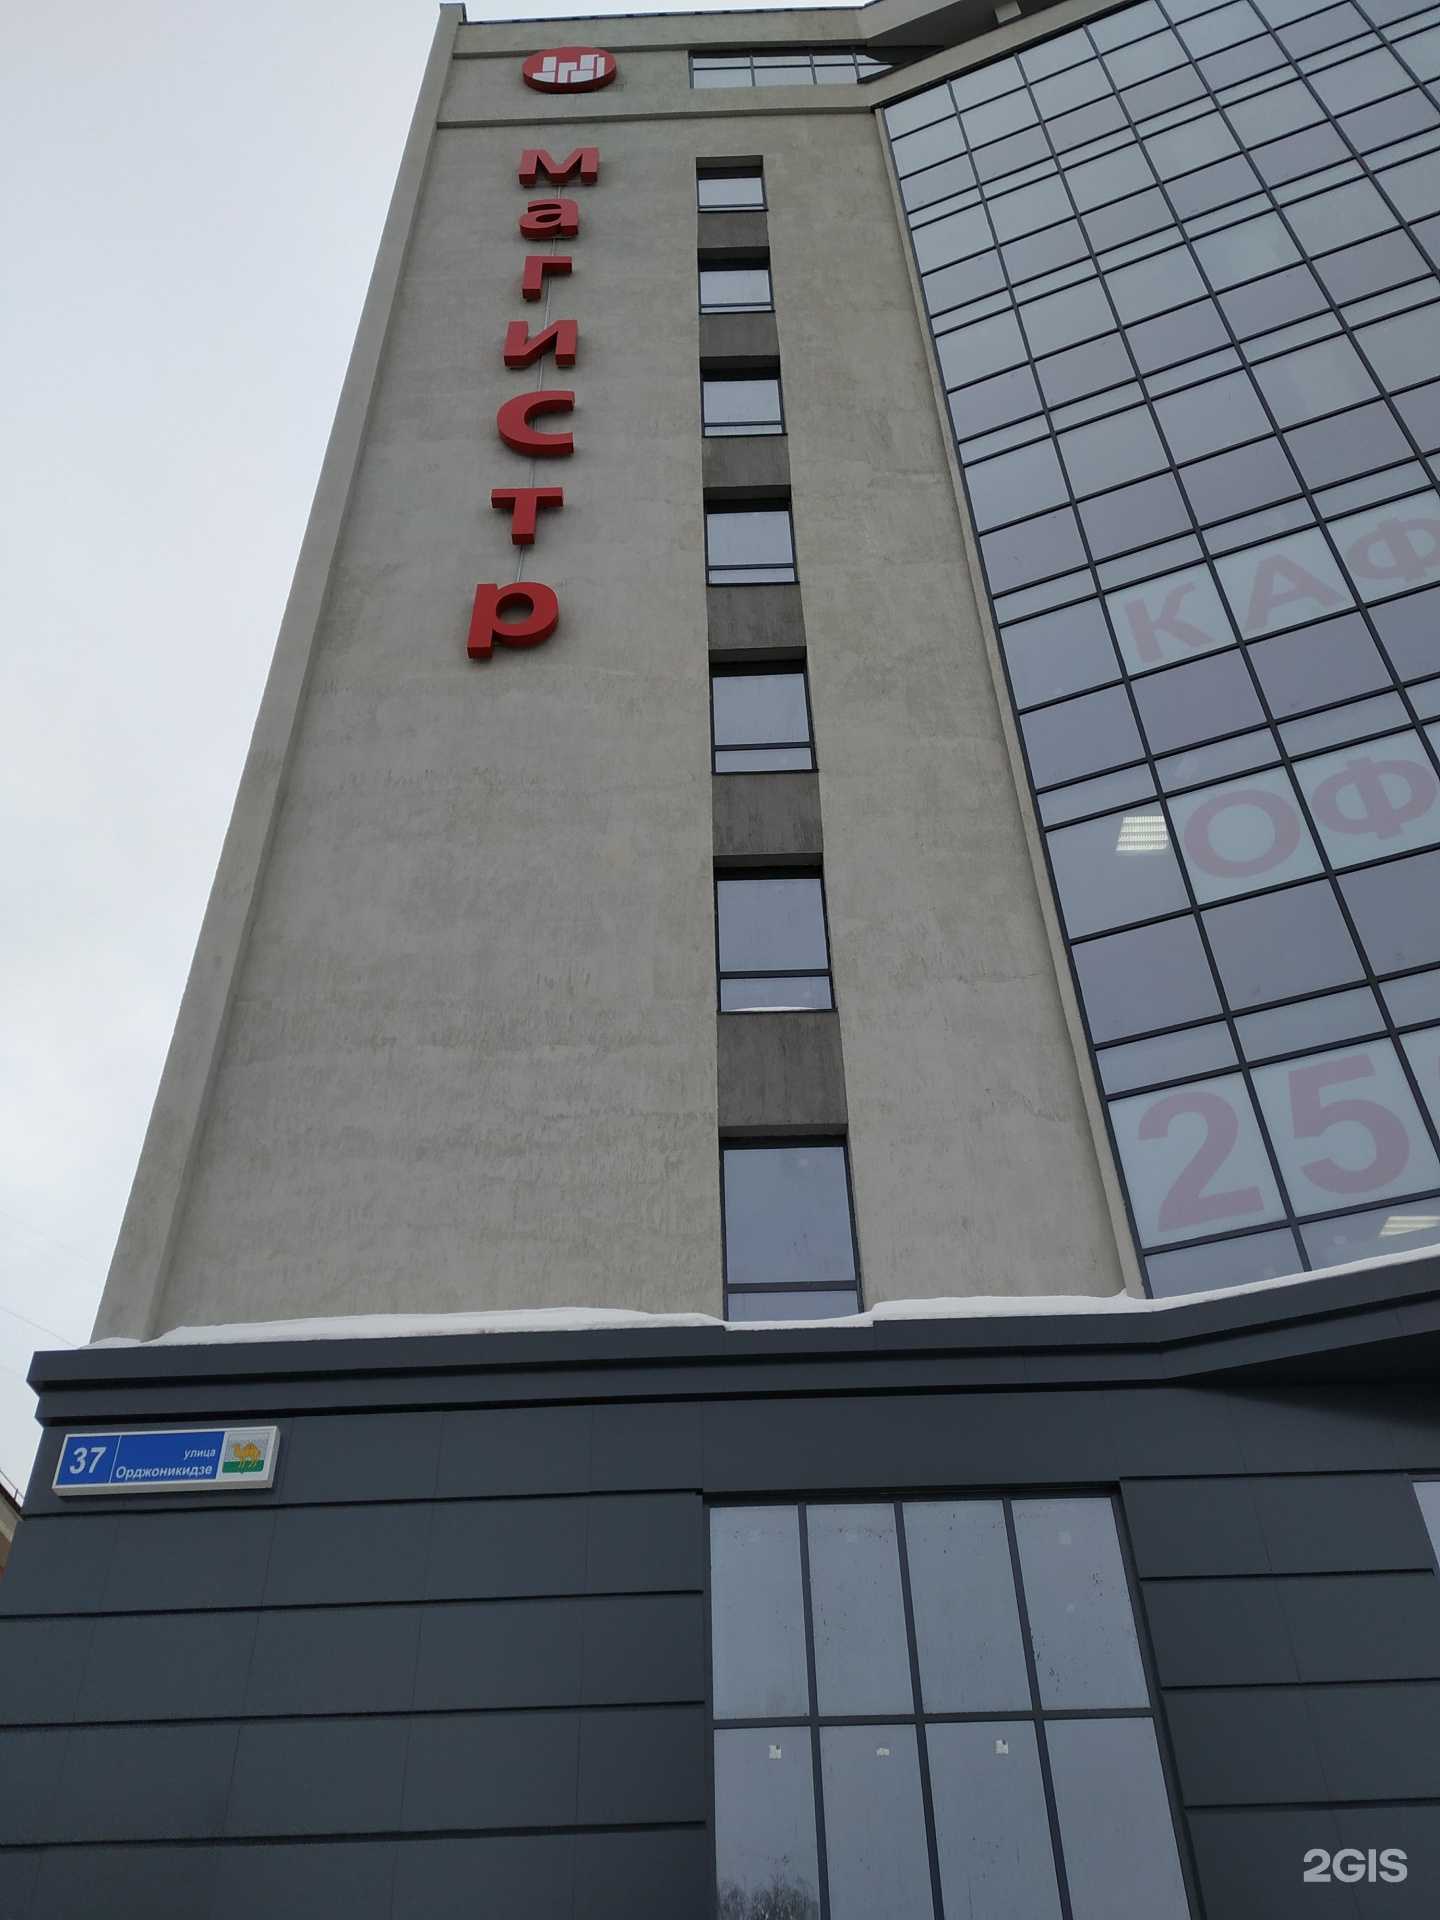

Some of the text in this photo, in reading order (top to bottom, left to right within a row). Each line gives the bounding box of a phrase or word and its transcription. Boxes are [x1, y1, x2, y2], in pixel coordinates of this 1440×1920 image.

[69, 1447, 106, 1474] 37
[184, 1448, 216, 1460] улица
[115, 1465, 213, 1480] Орджоникидзе
